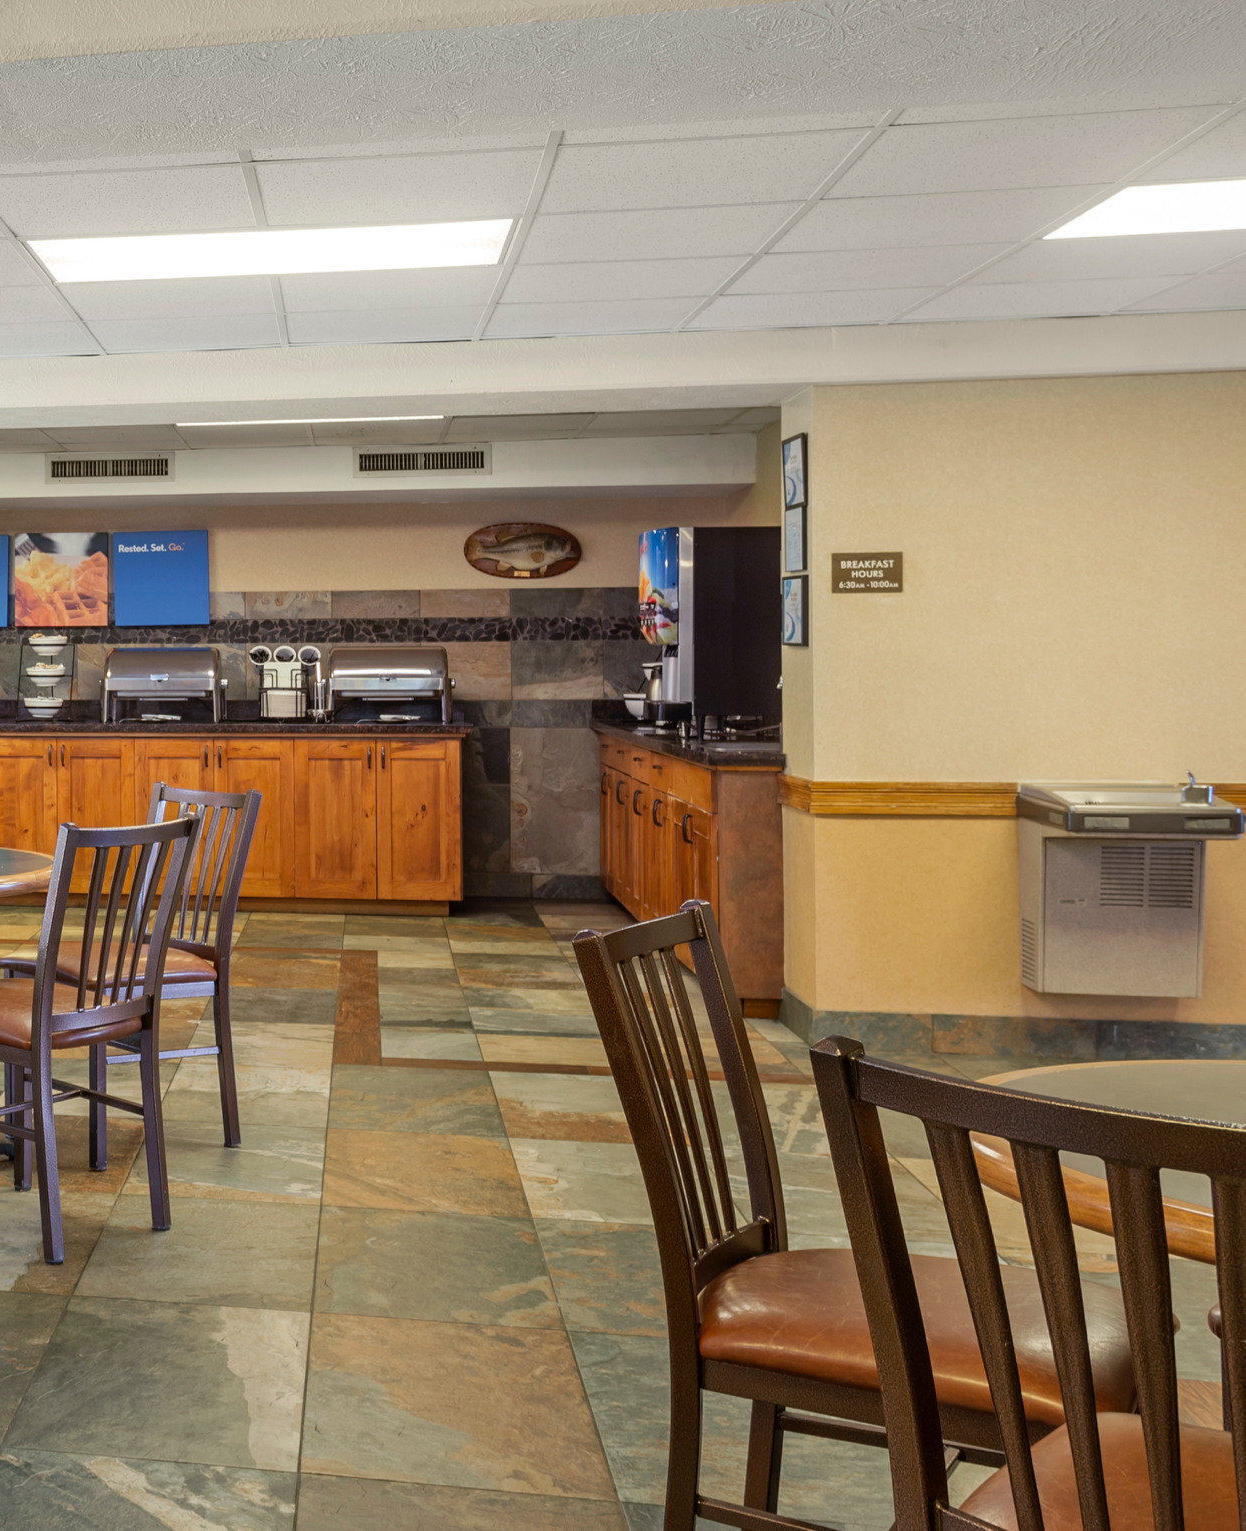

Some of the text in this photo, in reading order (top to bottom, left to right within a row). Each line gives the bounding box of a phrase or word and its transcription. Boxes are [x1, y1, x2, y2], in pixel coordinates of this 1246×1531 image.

[118, 544, 149, 552] Rested.
[151, 543, 167, 552] Set.
[840, 560, 895, 569] BREAKFAST
[851, 570, 884, 578] HOURS
